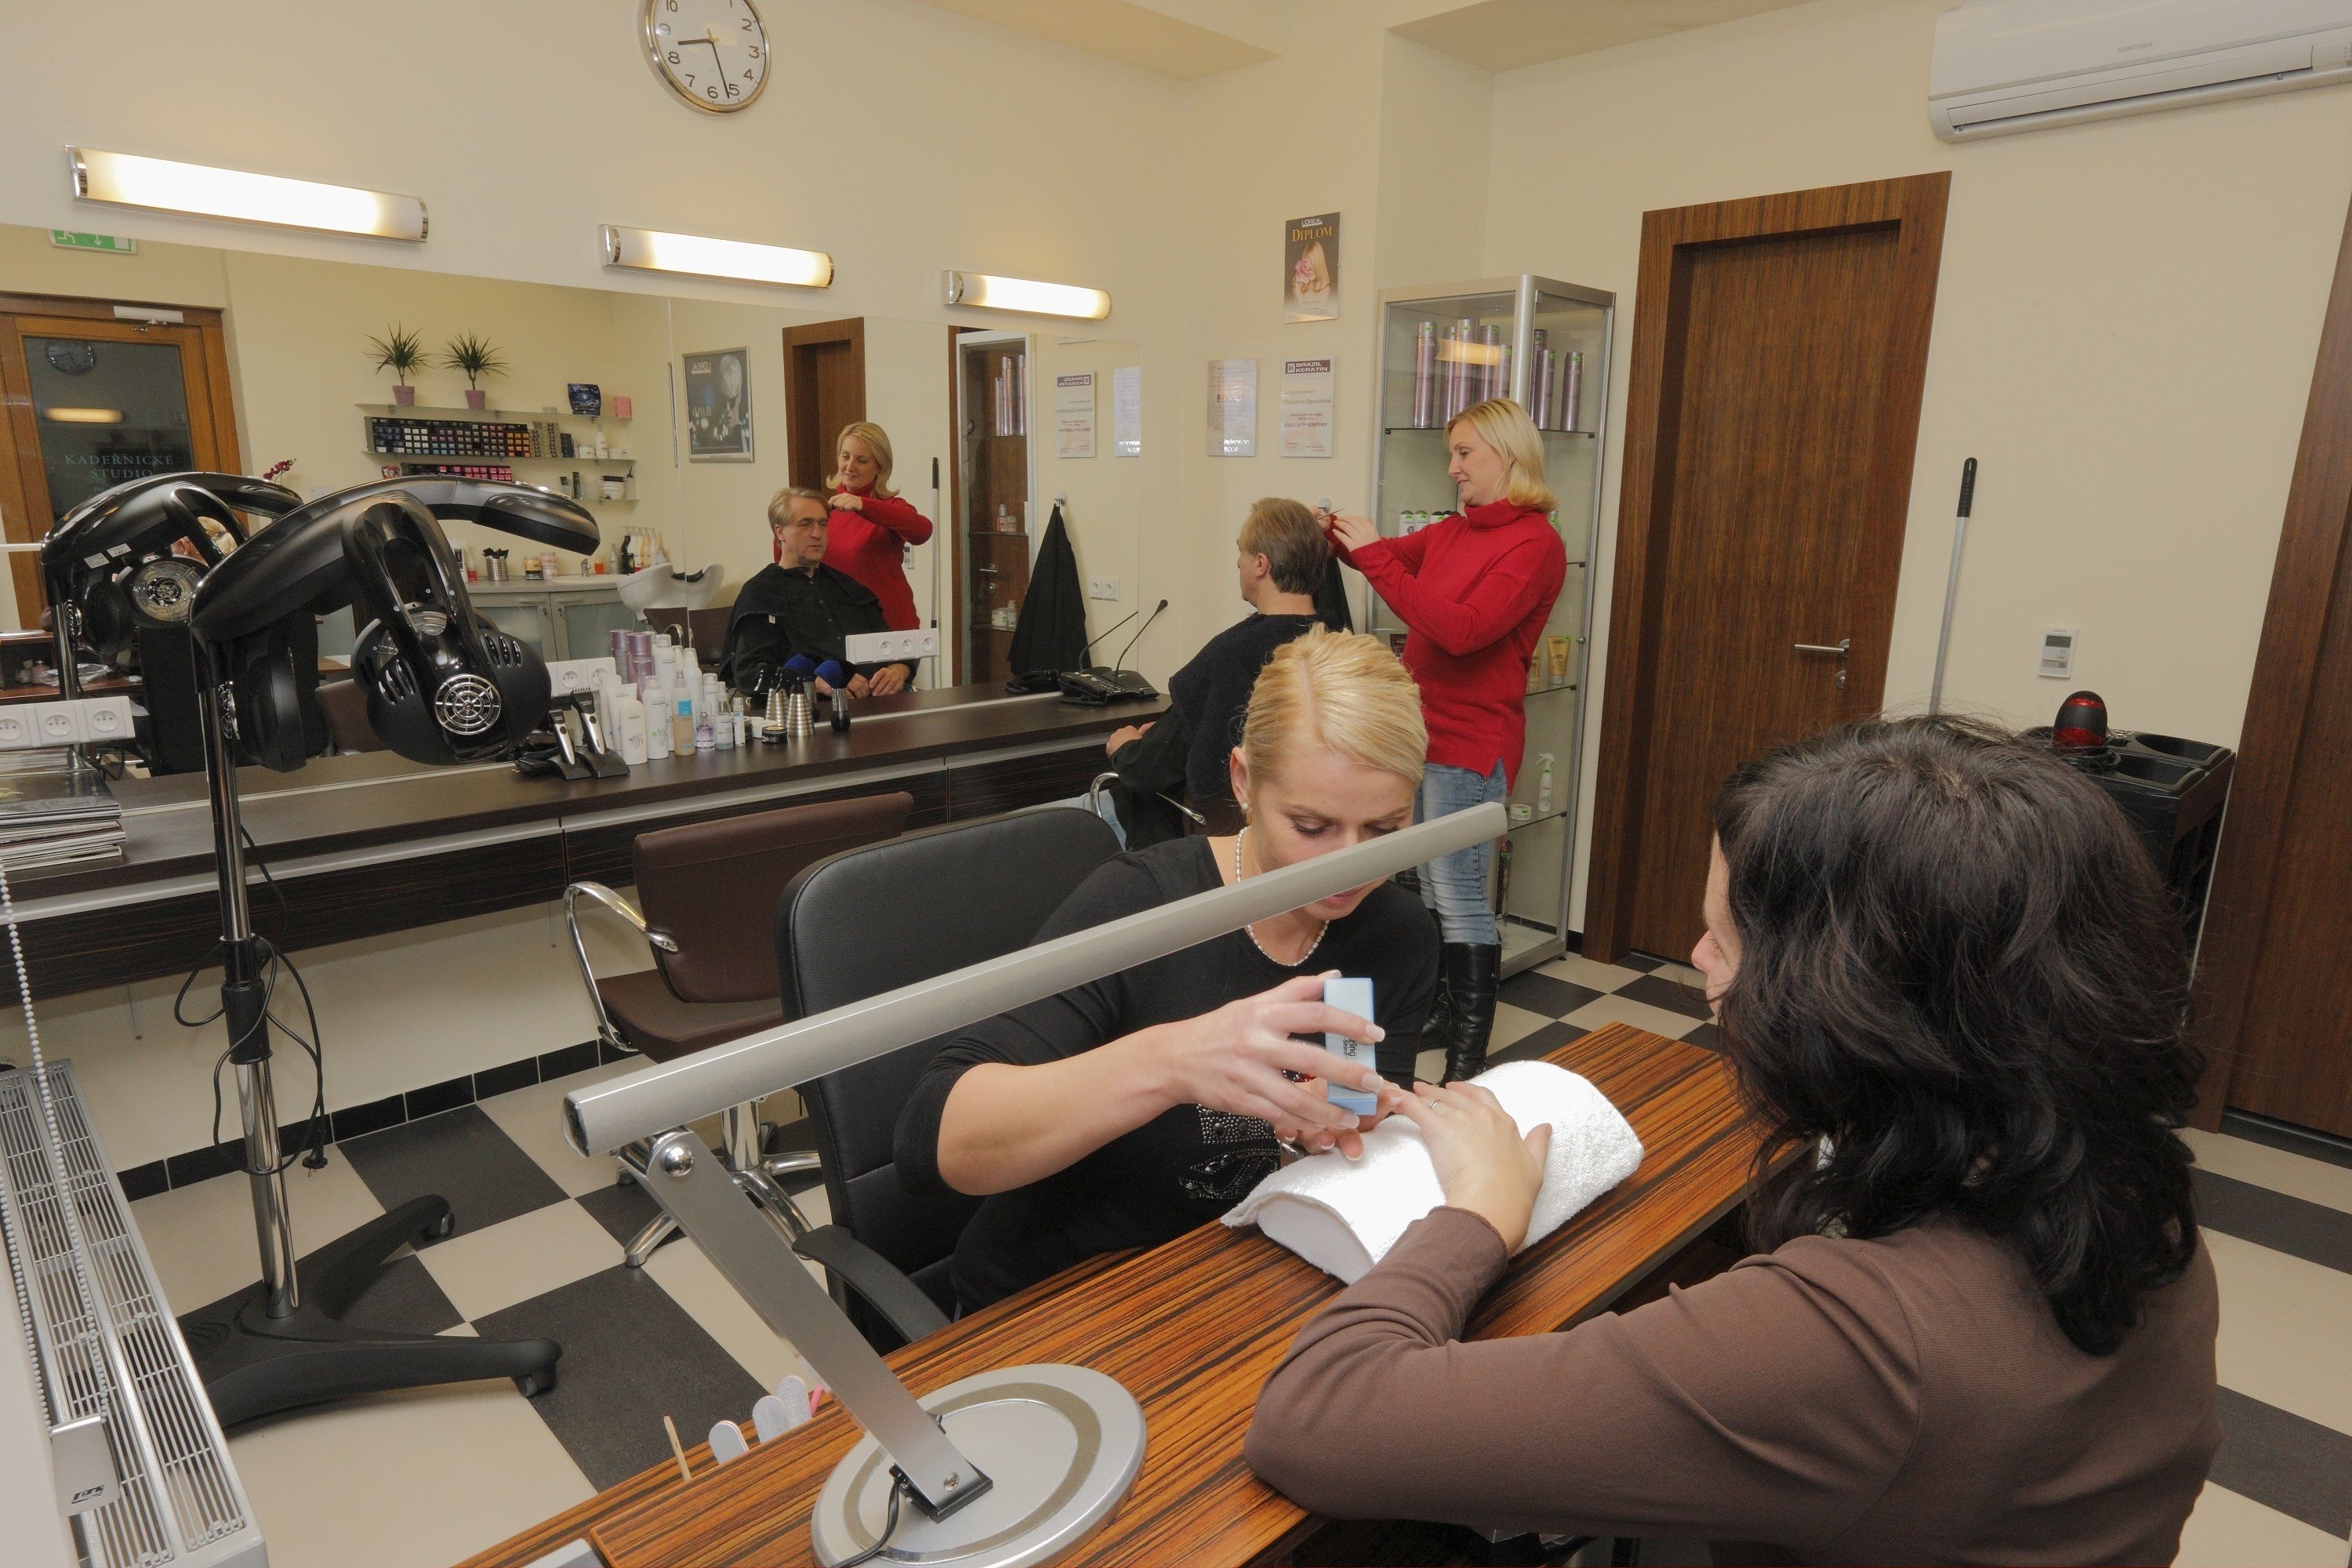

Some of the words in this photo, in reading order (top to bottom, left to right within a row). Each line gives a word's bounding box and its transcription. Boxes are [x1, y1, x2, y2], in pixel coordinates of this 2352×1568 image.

[659, 23, 672, 36] 9
[741, 18, 753, 32] 2
[748, 45, 760, 59] 3
[2118, 42, 2153, 53] SAMSUNG
[667, 51, 681, 65] 8
[684, 73, 696, 88] 7
[742, 68, 754, 82] 4
[706, 85, 719, 100] 6
[728, 83, 741, 96] 5
[1291, 225, 1333, 242] DIPLOM
[66, 453, 174, 465] KADEŘNICKÉ
[90, 469, 153, 479] STUDIO
